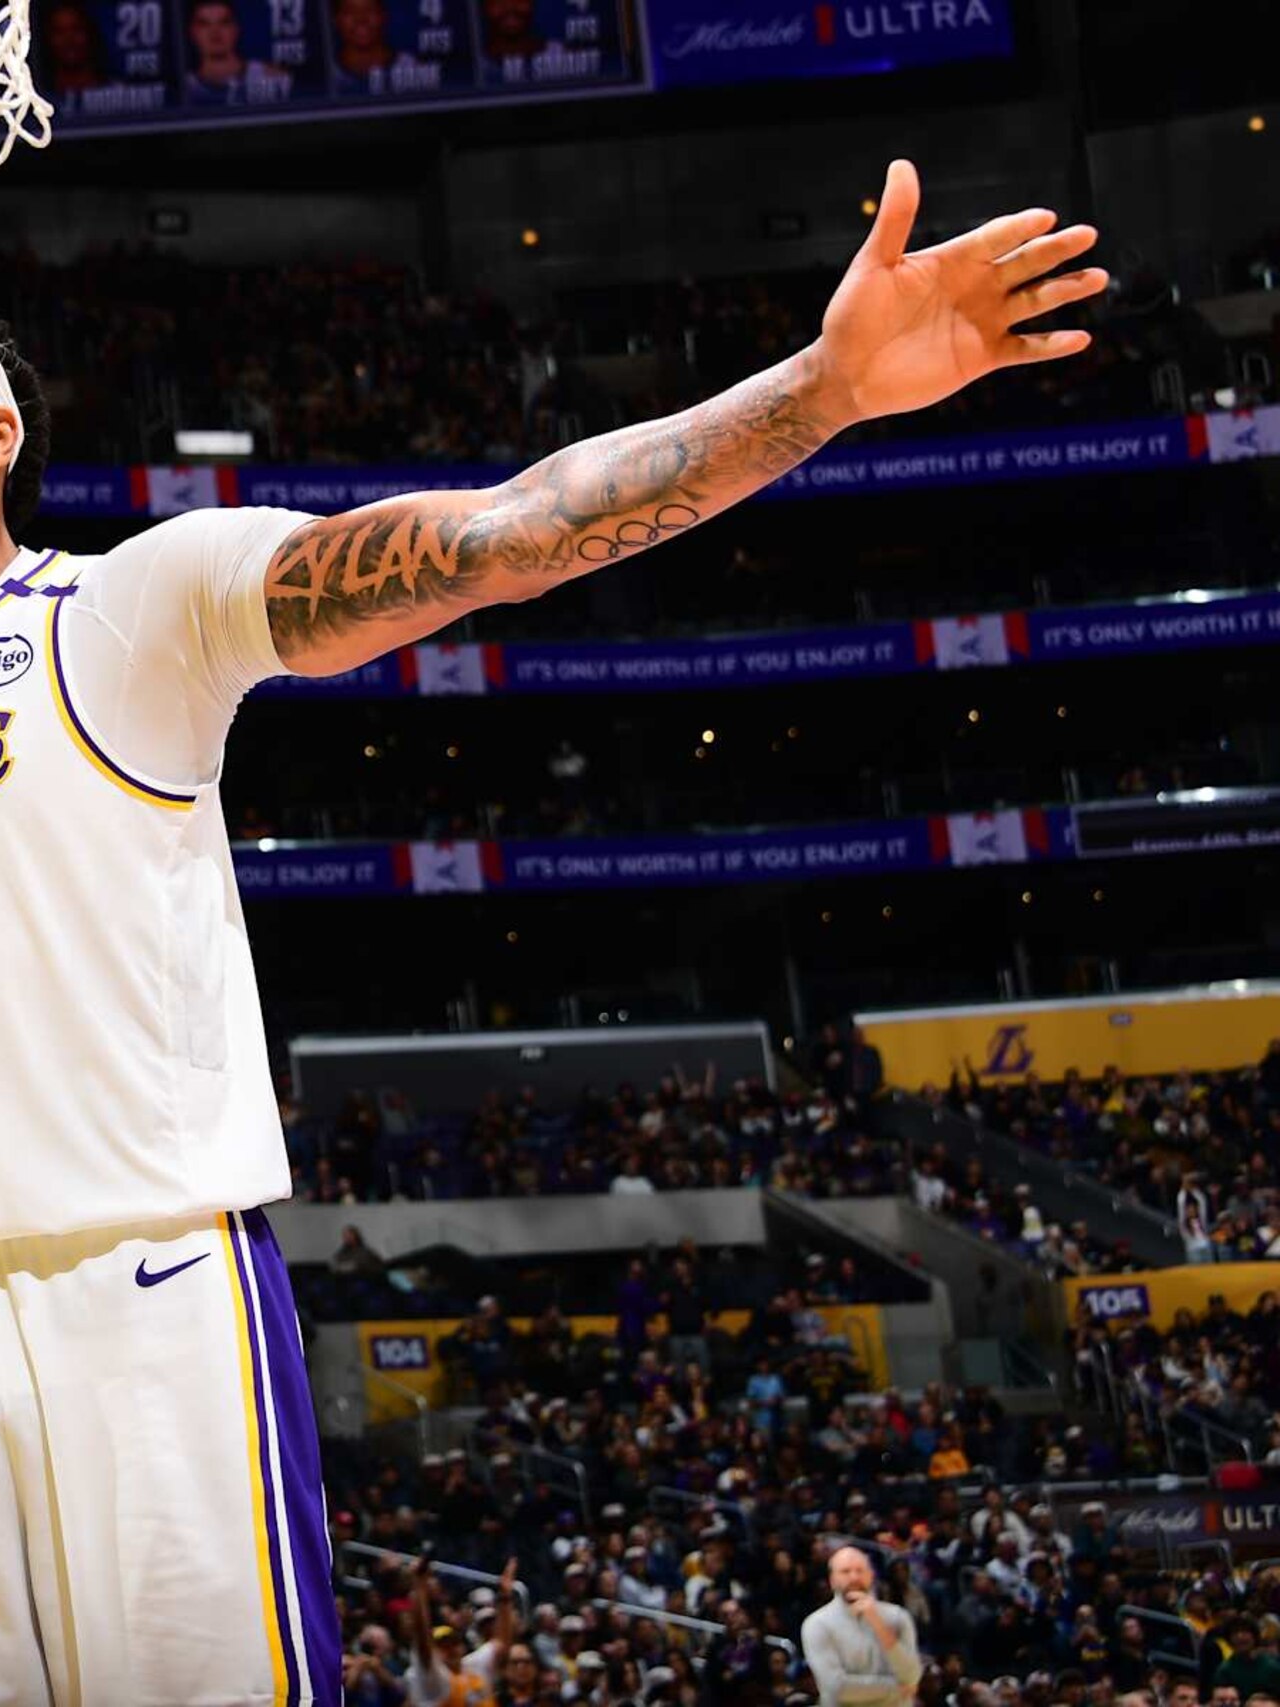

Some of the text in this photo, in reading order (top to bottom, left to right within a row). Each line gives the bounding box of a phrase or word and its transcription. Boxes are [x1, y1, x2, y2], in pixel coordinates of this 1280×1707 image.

[116, 2, 163, 48] 20
[843, 0, 993, 39] ULTRA
[809, 461, 868, 486] ONLY
[872, 449, 957, 481] WORTH
[960, 450, 982, 474] IT
[985, 446, 1008, 471] IF
[1011, 442, 1061, 469] YOU
[1065, 434, 1142, 465] ENJOY
[1147, 432, 1170, 457] IT
[251, 481, 288, 505] IT'S
[292, 480, 347, 506] ONLY
[1042, 624, 1083, 650] IT'S
[1086, 619, 1147, 648] ONLY
[1149, 611, 1237, 644] WORTH
[1240, 609, 1264, 636] IT
[517, 641, 894, 684] IT'S ONLY WORTH IT IF YOU ENJOY IT
[277, 861, 346, 888] ENJOY
[354, 861, 377, 886] IT
[515, 836, 909, 881] IT'S ONLY WORTH IT IF YOU ENJOY IT
[1084, 1287, 1142, 1317] 105
